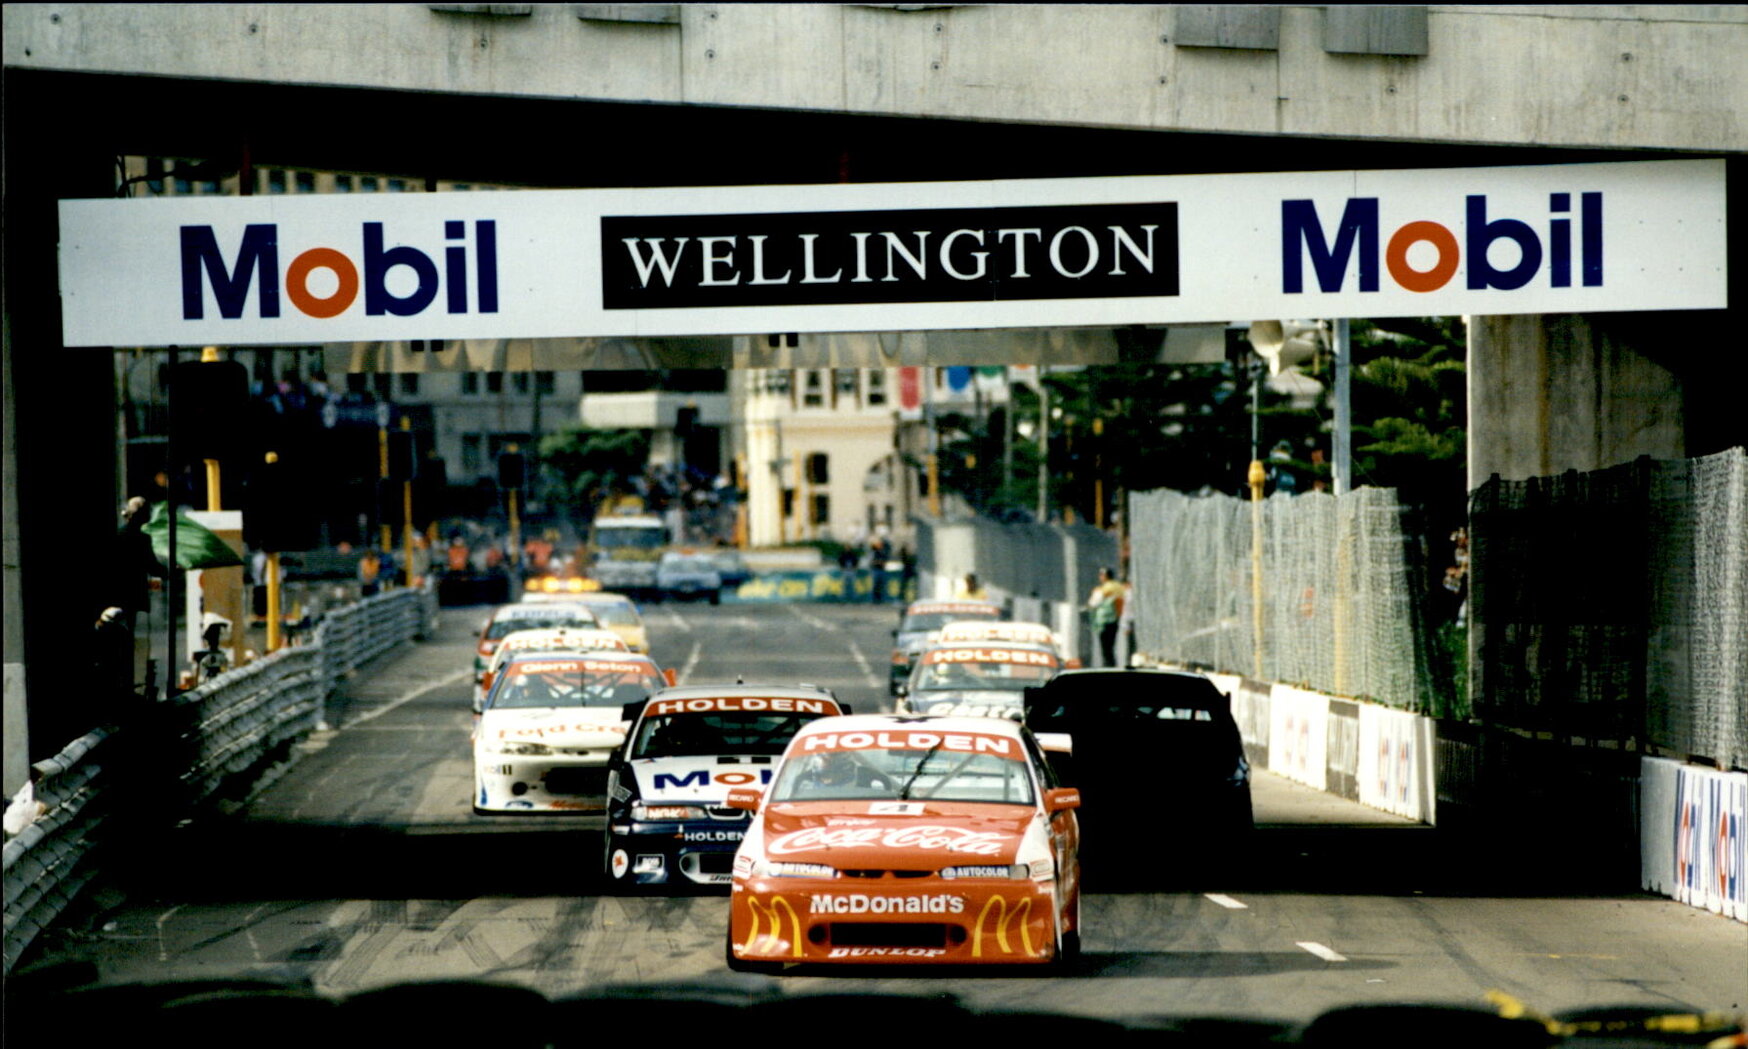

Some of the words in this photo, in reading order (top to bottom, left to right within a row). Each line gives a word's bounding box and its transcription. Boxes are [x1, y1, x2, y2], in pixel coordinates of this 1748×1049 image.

[1281, 192, 1603, 294] Mobil
[622, 224, 1159, 289] WELLINGTON
[180, 219, 499, 320] Mobil
[932, 650, 1050, 665] HOLDEN
[658, 698, 824, 715] HOLDEN
[803, 732, 1010, 754] HOLDEN
[957, 865, 1009, 878] AUTOCOLOR
[809, 894, 965, 914] McDonald's
[827, 946, 947, 958] DUNLOP
